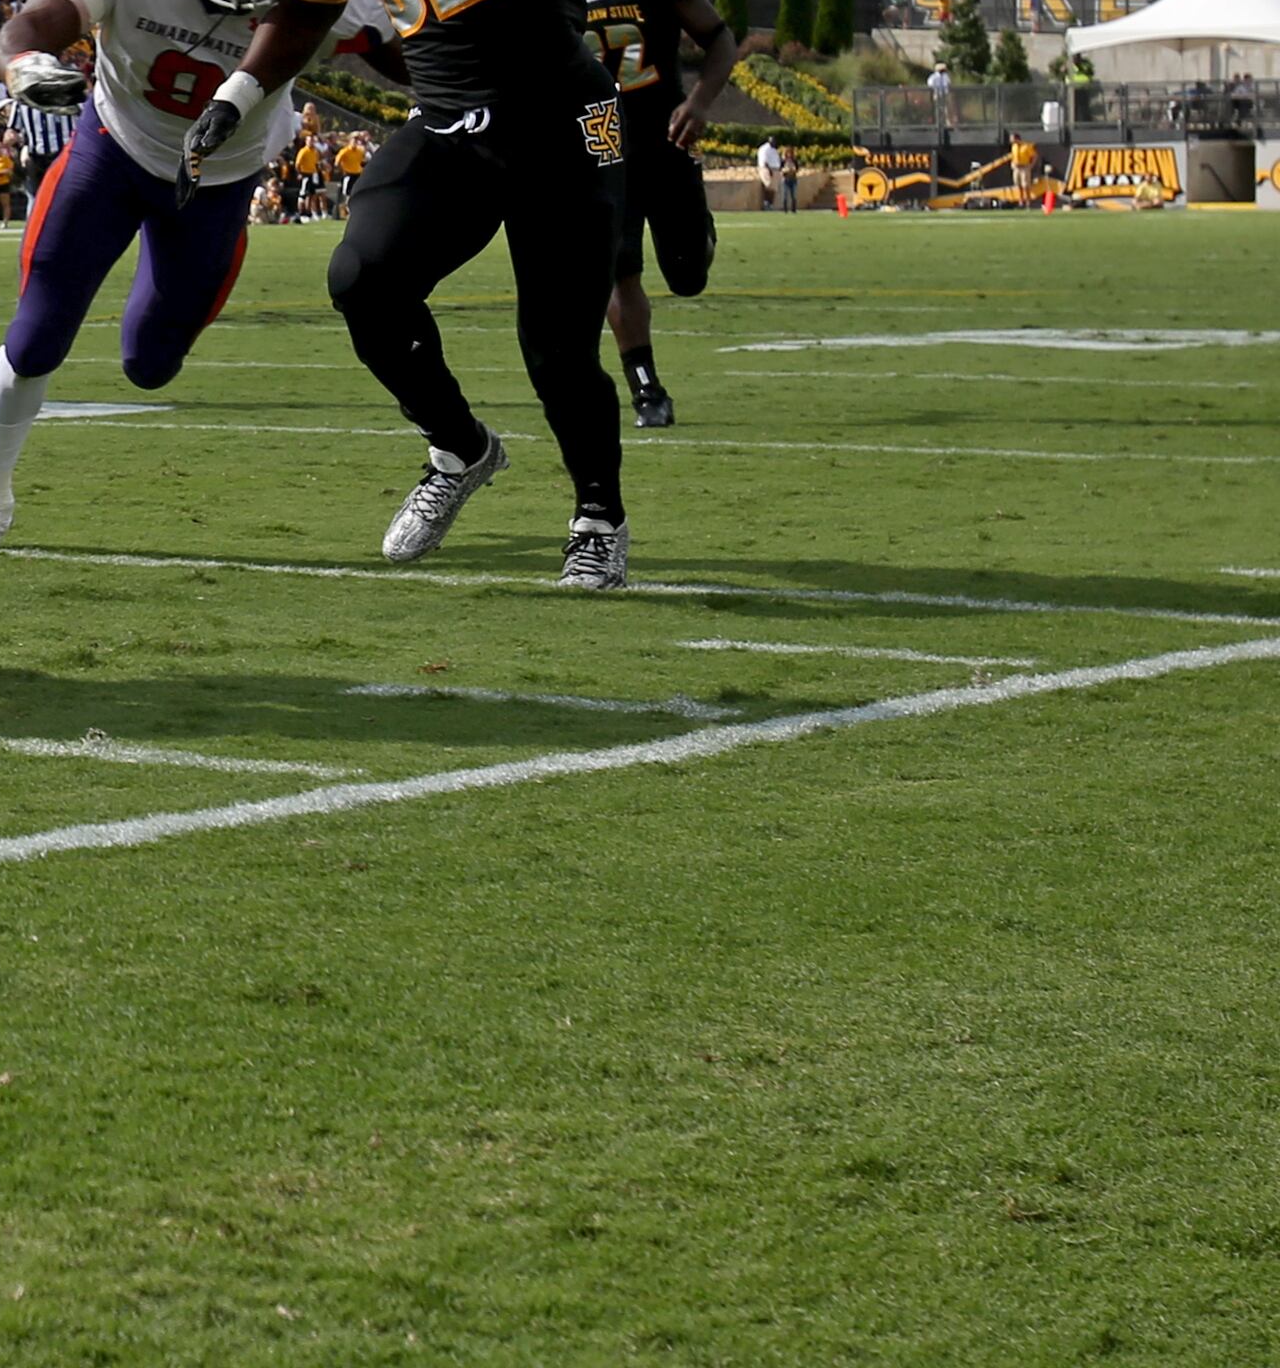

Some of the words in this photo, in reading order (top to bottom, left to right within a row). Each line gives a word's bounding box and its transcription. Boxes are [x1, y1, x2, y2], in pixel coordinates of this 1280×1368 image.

[609, 4, 646, 23] STATE
[135, 17, 203, 45] EDWARD
[143, 49, 228, 121] 9
[896, 153, 930, 164] BLACK
[1065, 146, 1183, 193] KENNESAW
